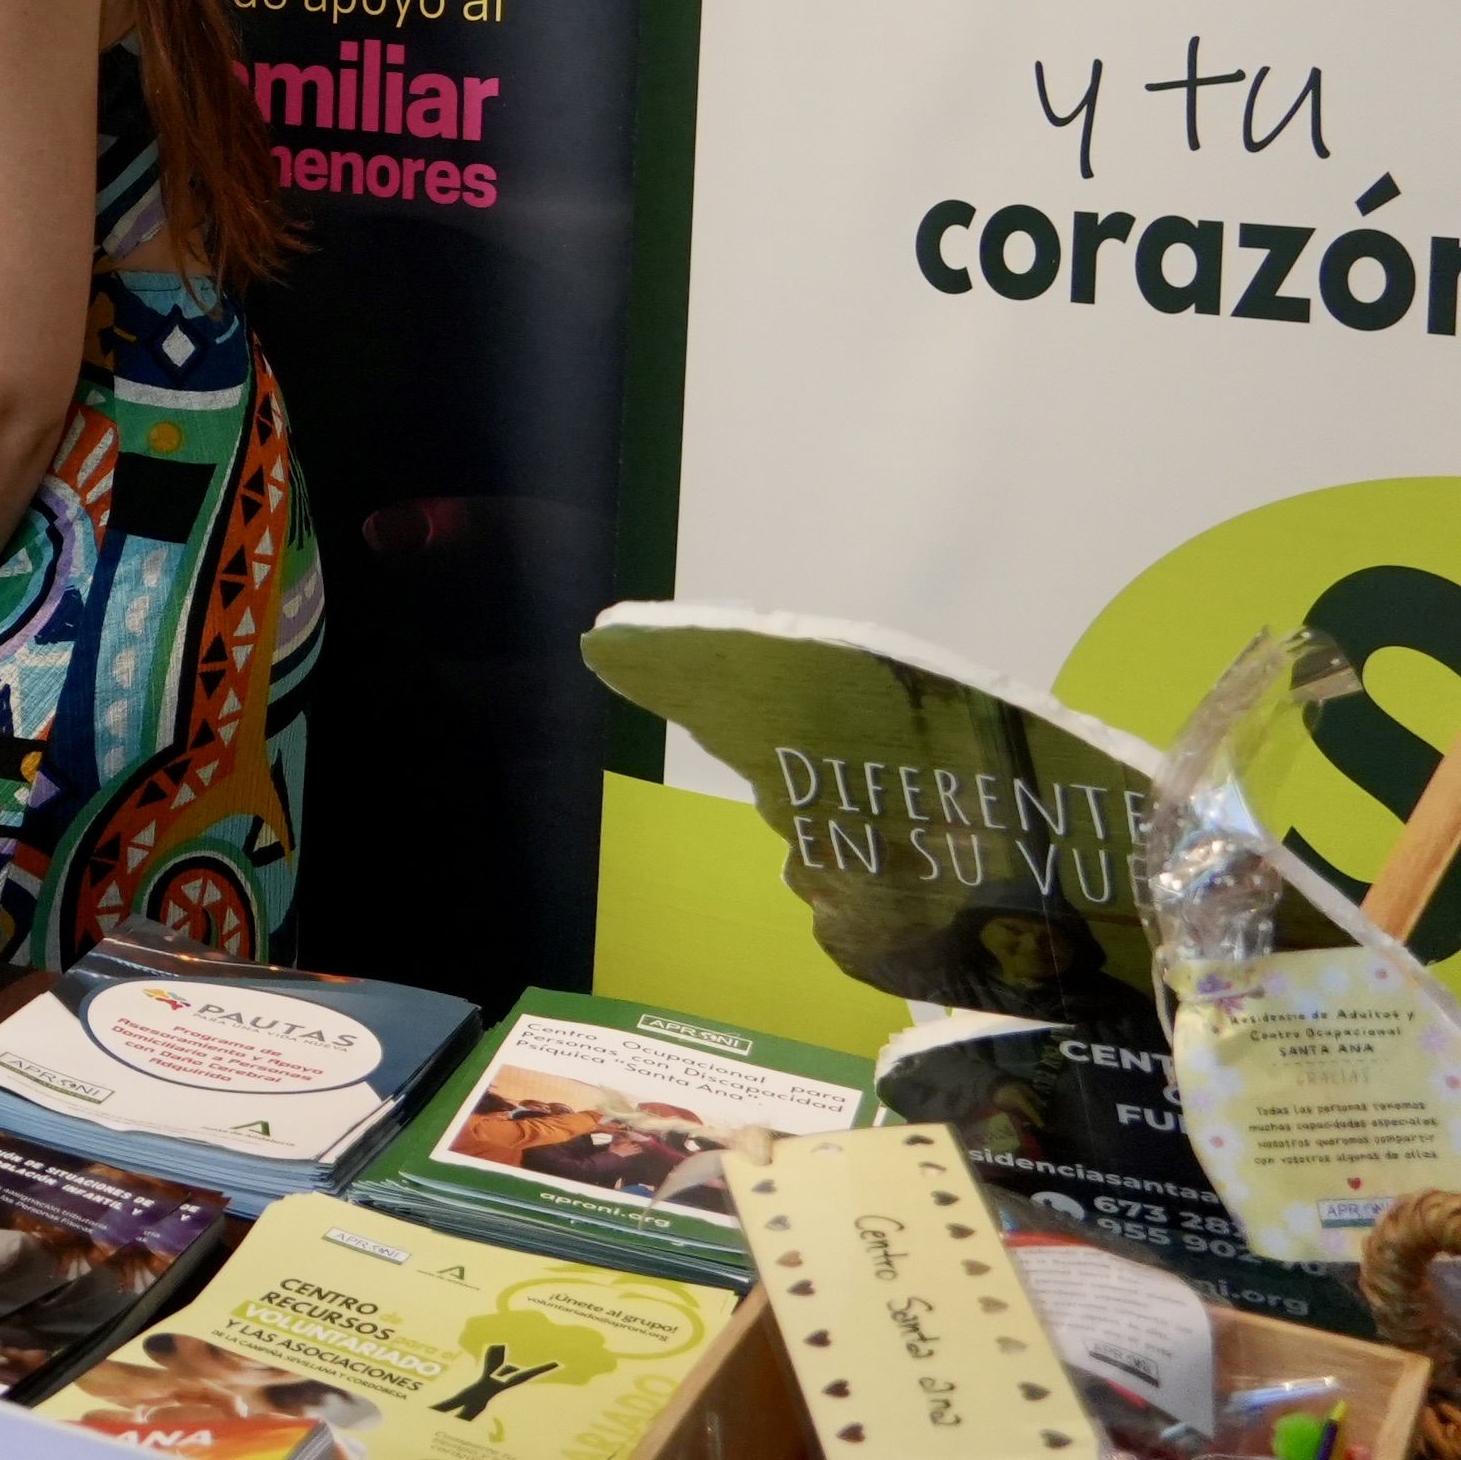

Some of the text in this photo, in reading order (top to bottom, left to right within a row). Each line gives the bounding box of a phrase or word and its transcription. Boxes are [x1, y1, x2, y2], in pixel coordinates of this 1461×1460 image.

[232, 38, 500, 141] miliar
[1033, 34, 1332, 180] y tu
[775, 746, 1150, 844] DIFERENTE
[792, 816, 983, 888] EN SU
[116, 1017, 325, 1076] Asesoramiento Apoyo
[173, 1025, 283, 1057] Programa de
[196, 1003, 359, 1048] PAUTAS
[647, 1018, 742, 1049] APRONI
[1249, 1029, 1300, 1042] Centro
[111, 1024, 313, 1082] Domiciliario Personas
[124, 1040, 283, 1084] con Daño Cerebral
[148, 1056, 233, 1082] Adquirido
[515, 1038, 606, 1066] psíquica
[521, 1030, 845, 1114] personas con Discapacidad
[527, 1022, 847, 1104] Centro Ocupacional para
[1279, 1043, 1375, 1058] SANTA ANA
[7, 1058, 101, 1099] APRONI
[24, 1158, 46, 1172] DE
[133, 1192, 156, 1208] DE
[539, 1190, 672, 1230] aproni.org
[1093, 1194, 1170, 1224] 673
[1096, 1216, 1172, 1246] 955
[854, 1215, 909, 1281] Centro
[260, 1291, 397, 1341] RECURSOS
[279, 1278, 380, 1316] CENTRO
[606, 1306, 624, 1319] al
[238, 1324, 425, 1392] LAS ASOCIACIONES
[245, 1303, 443, 1377] VOLUNTARIADO
